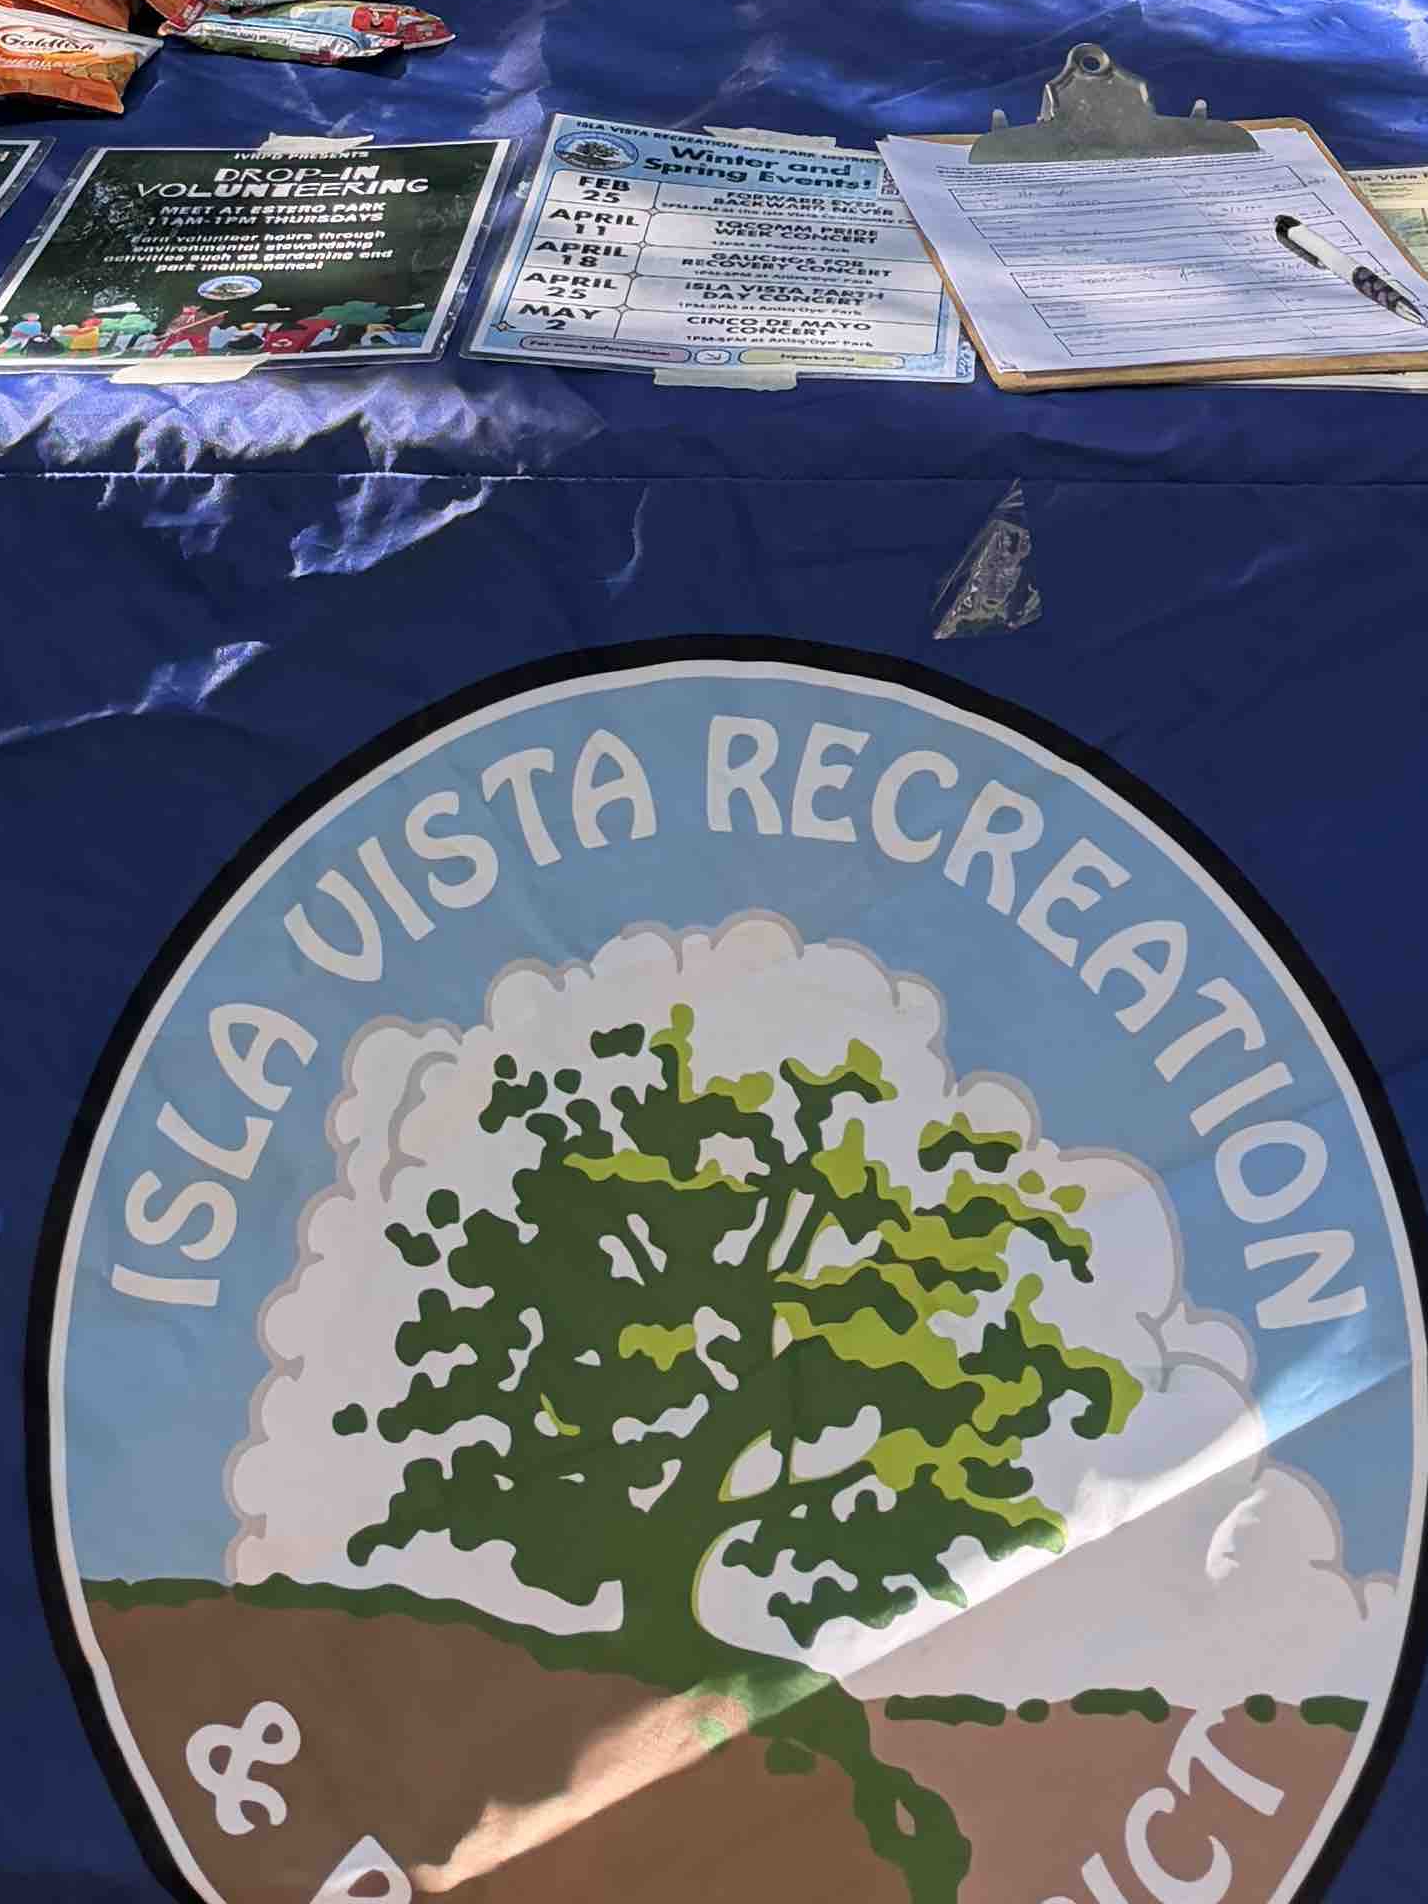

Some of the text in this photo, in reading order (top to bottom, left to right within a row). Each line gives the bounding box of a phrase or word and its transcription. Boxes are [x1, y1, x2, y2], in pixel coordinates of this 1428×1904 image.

[0, 31, 95, 51] Goldfish
[575, 121, 605, 131] ISLA
[610, 125, 650, 137] VISTA
[652, 131, 739, 149] RECREATION
[778, 148, 815, 158] PARK
[670, 145, 852, 177] Winter and
[213, 166, 381, 182] DROP-IN
[642, 157, 872, 190] Spring Events!
[135, 178, 429, 198] VOLUNTEERING
[578, 175, 631, 192] FEB
[581, 189, 621, 203] 25
[726, 192, 824, 205] FORWARD
[159, 202, 387, 215] MEET AT ESTERO PARK
[713, 198, 894, 216] BACKWARD NEVER
[147, 213, 383, 225] 11AM-1PM THURSDAYS
[548, 208, 640, 226] APRIL
[176, 235, 259, 243] volunteer
[264, 233, 313, 241] hours
[317, 230, 386, 241] through
[573, 223, 607, 236] 11
[714, 228, 878, 244] WEEK CONCERT
[820, 227, 879, 237] PRIDE
[132, 241, 374, 253] environmental stewardship
[534, 241, 629, 258] APRIL
[103, 254, 185, 263] activities
[263, 252, 354, 262] gardening
[359, 250, 394, 258] and
[560, 254, 598, 268] 18
[711, 252, 864, 267] GAUCHOS FOR
[156, 260, 323, 272] park maintenance!
[681, 258, 892, 277] RECOVERY CONCERT
[525, 272, 618, 289] APRIL
[546, 286, 588, 299] 25
[685, 282, 885, 300] ISLA VISTA EARTH
[702, 291, 865, 306] DAY CONCERT
[518, 304, 602, 320] MAY
[545, 319, 567, 330] 2
[687, 316, 872, 331] CINCO DE MAYO
[725, 326, 829, 336] CONCERT
[105, 713, 1368, 1333] ISLA VISTA RECREATION
[185, 1700, 302, 1836] &
